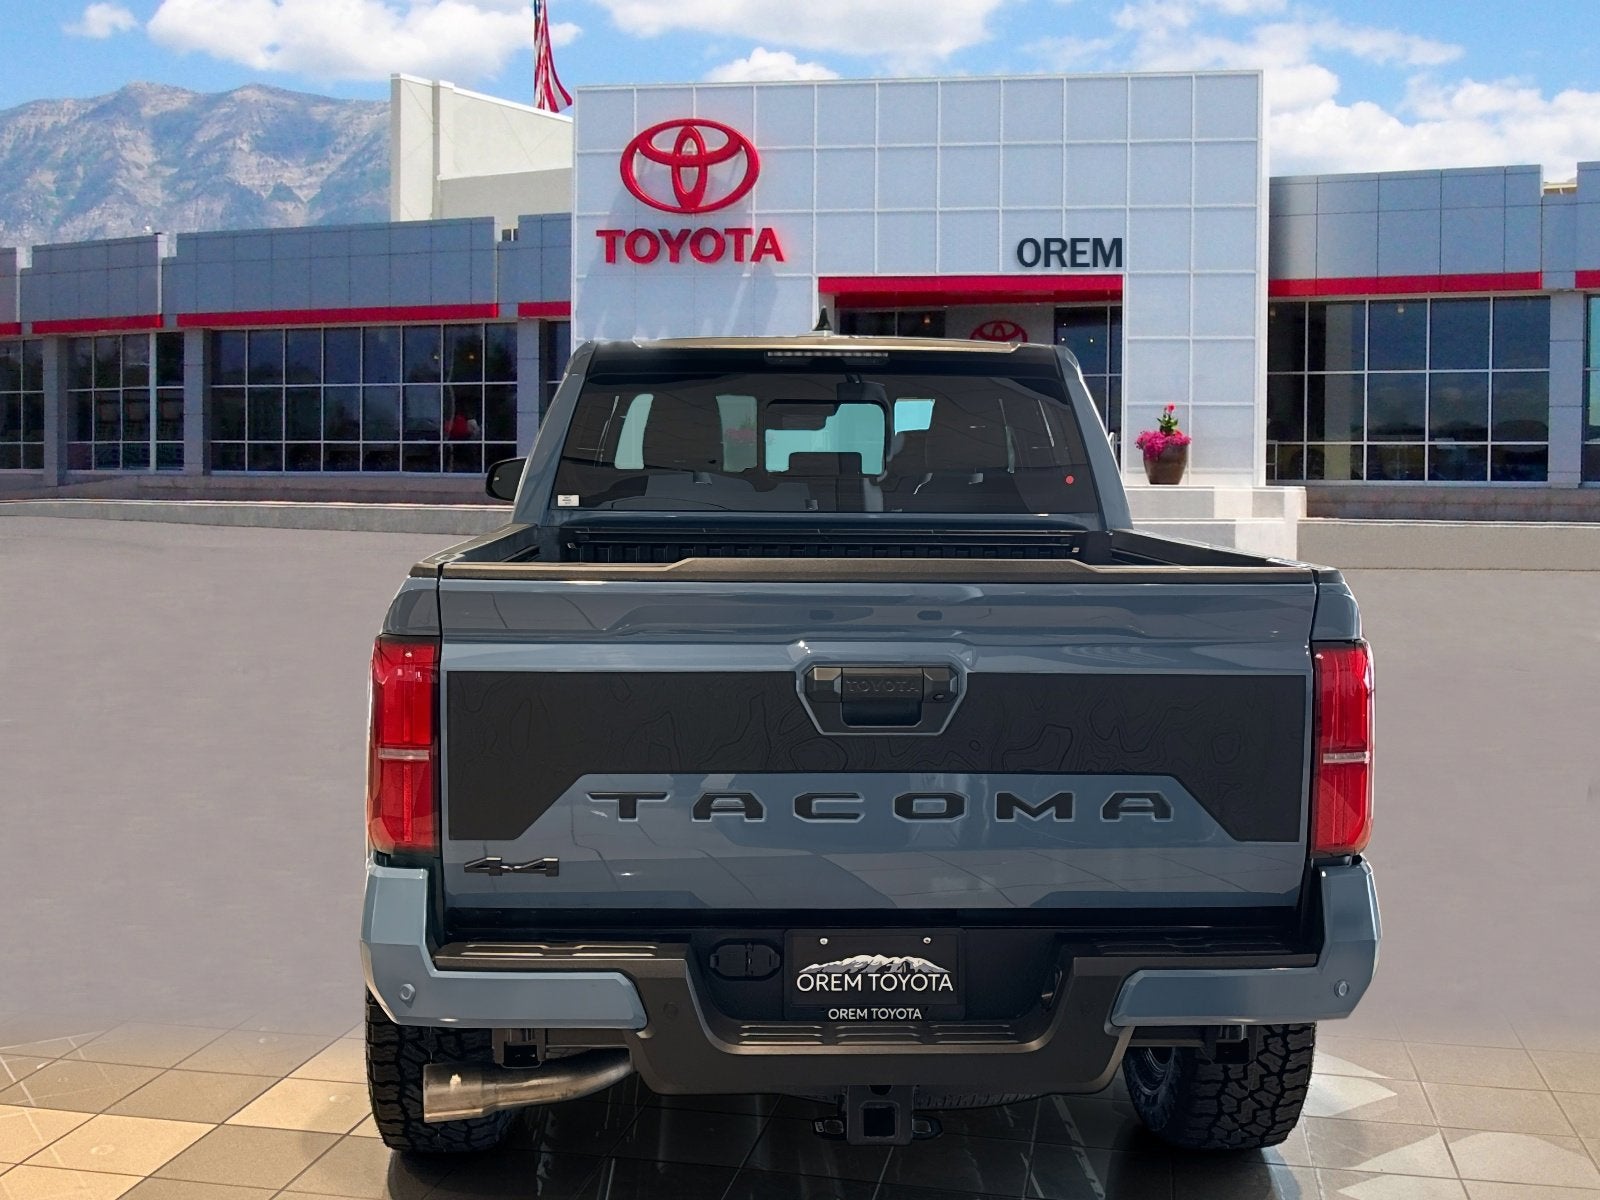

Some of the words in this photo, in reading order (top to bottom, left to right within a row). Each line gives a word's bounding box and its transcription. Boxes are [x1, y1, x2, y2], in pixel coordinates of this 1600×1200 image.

[596, 227, 785, 265] TOYOTA
[1016, 237, 1123, 268] OREM
[845, 679, 920, 692] TOYOTA
[586, 790, 1175, 823] TACOMA
[796, 973, 862, 992] OREM
[868, 973, 954, 992] TOYOTA
[828, 1008, 868, 1020] OREM
[871, 1007, 923, 1020] TOYOTA
